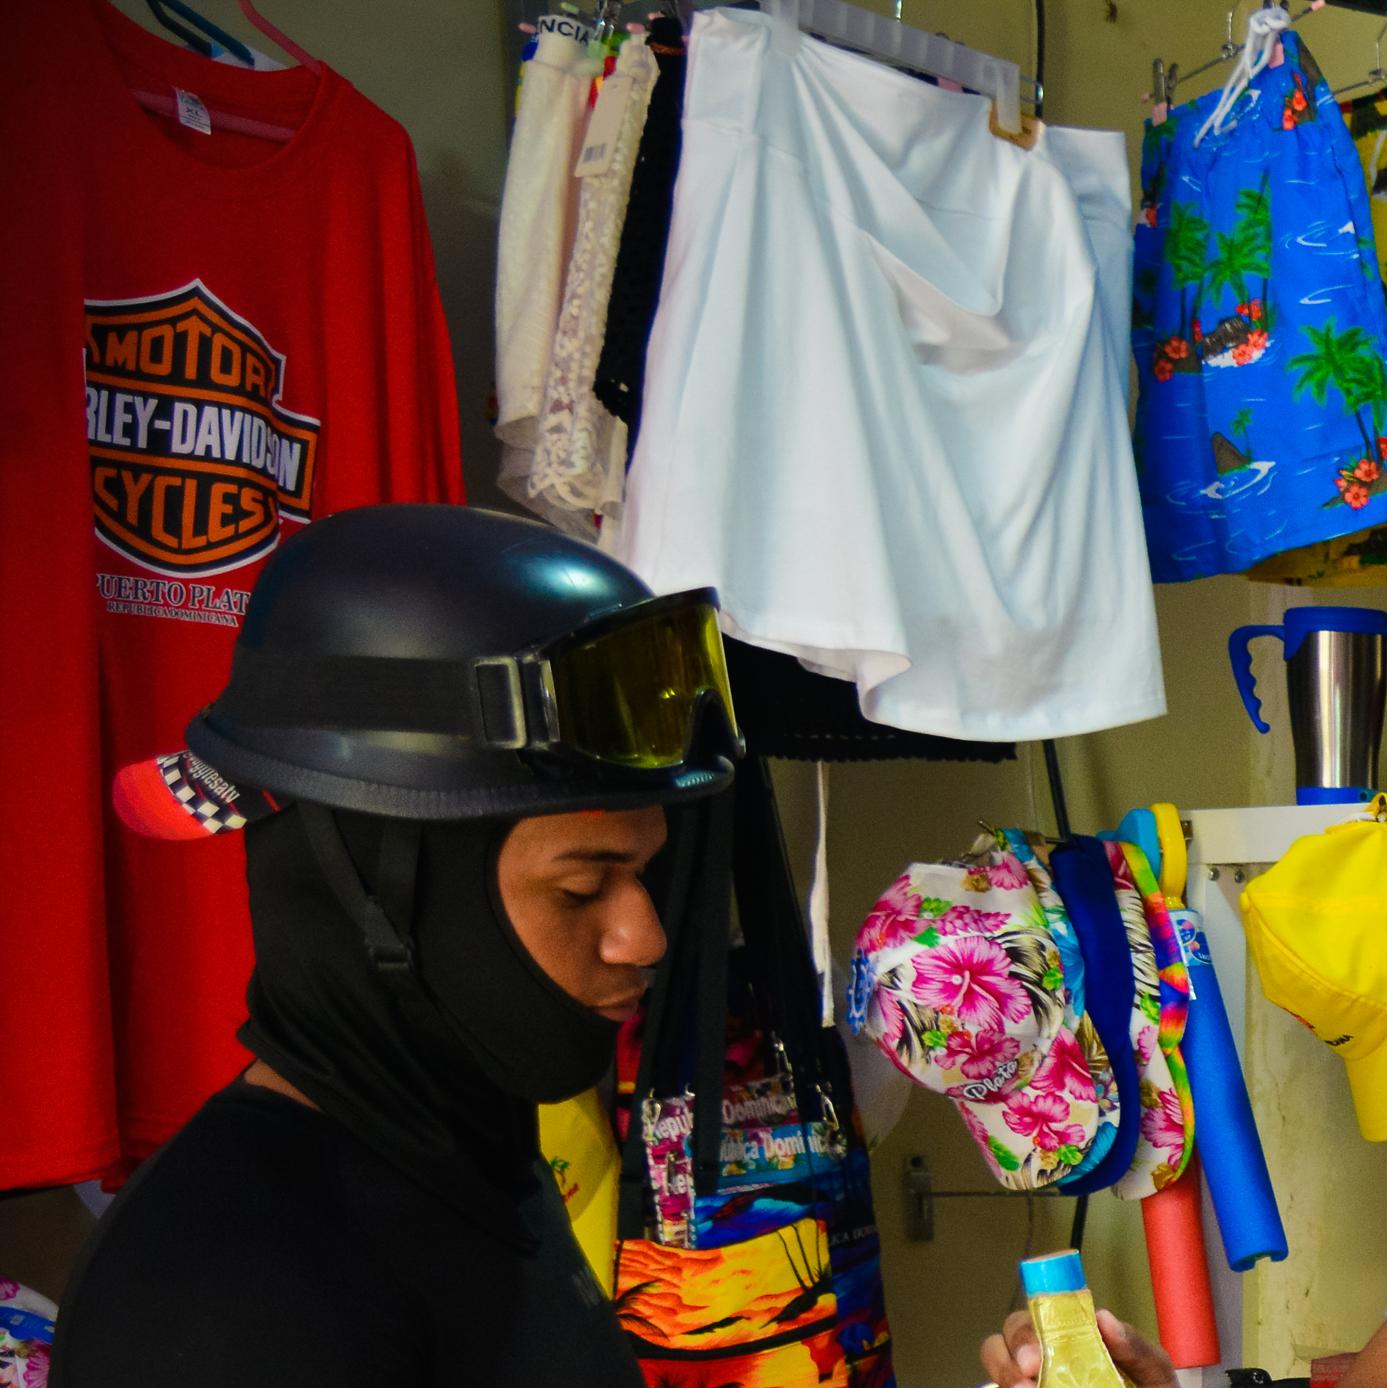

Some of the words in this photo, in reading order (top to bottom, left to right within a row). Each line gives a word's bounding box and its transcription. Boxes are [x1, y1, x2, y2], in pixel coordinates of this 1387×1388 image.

[94, 467, 268, 550] CYCLES
[97, 573, 186, 607] UERTO
[963, 1060, 1018, 1101] Plata
